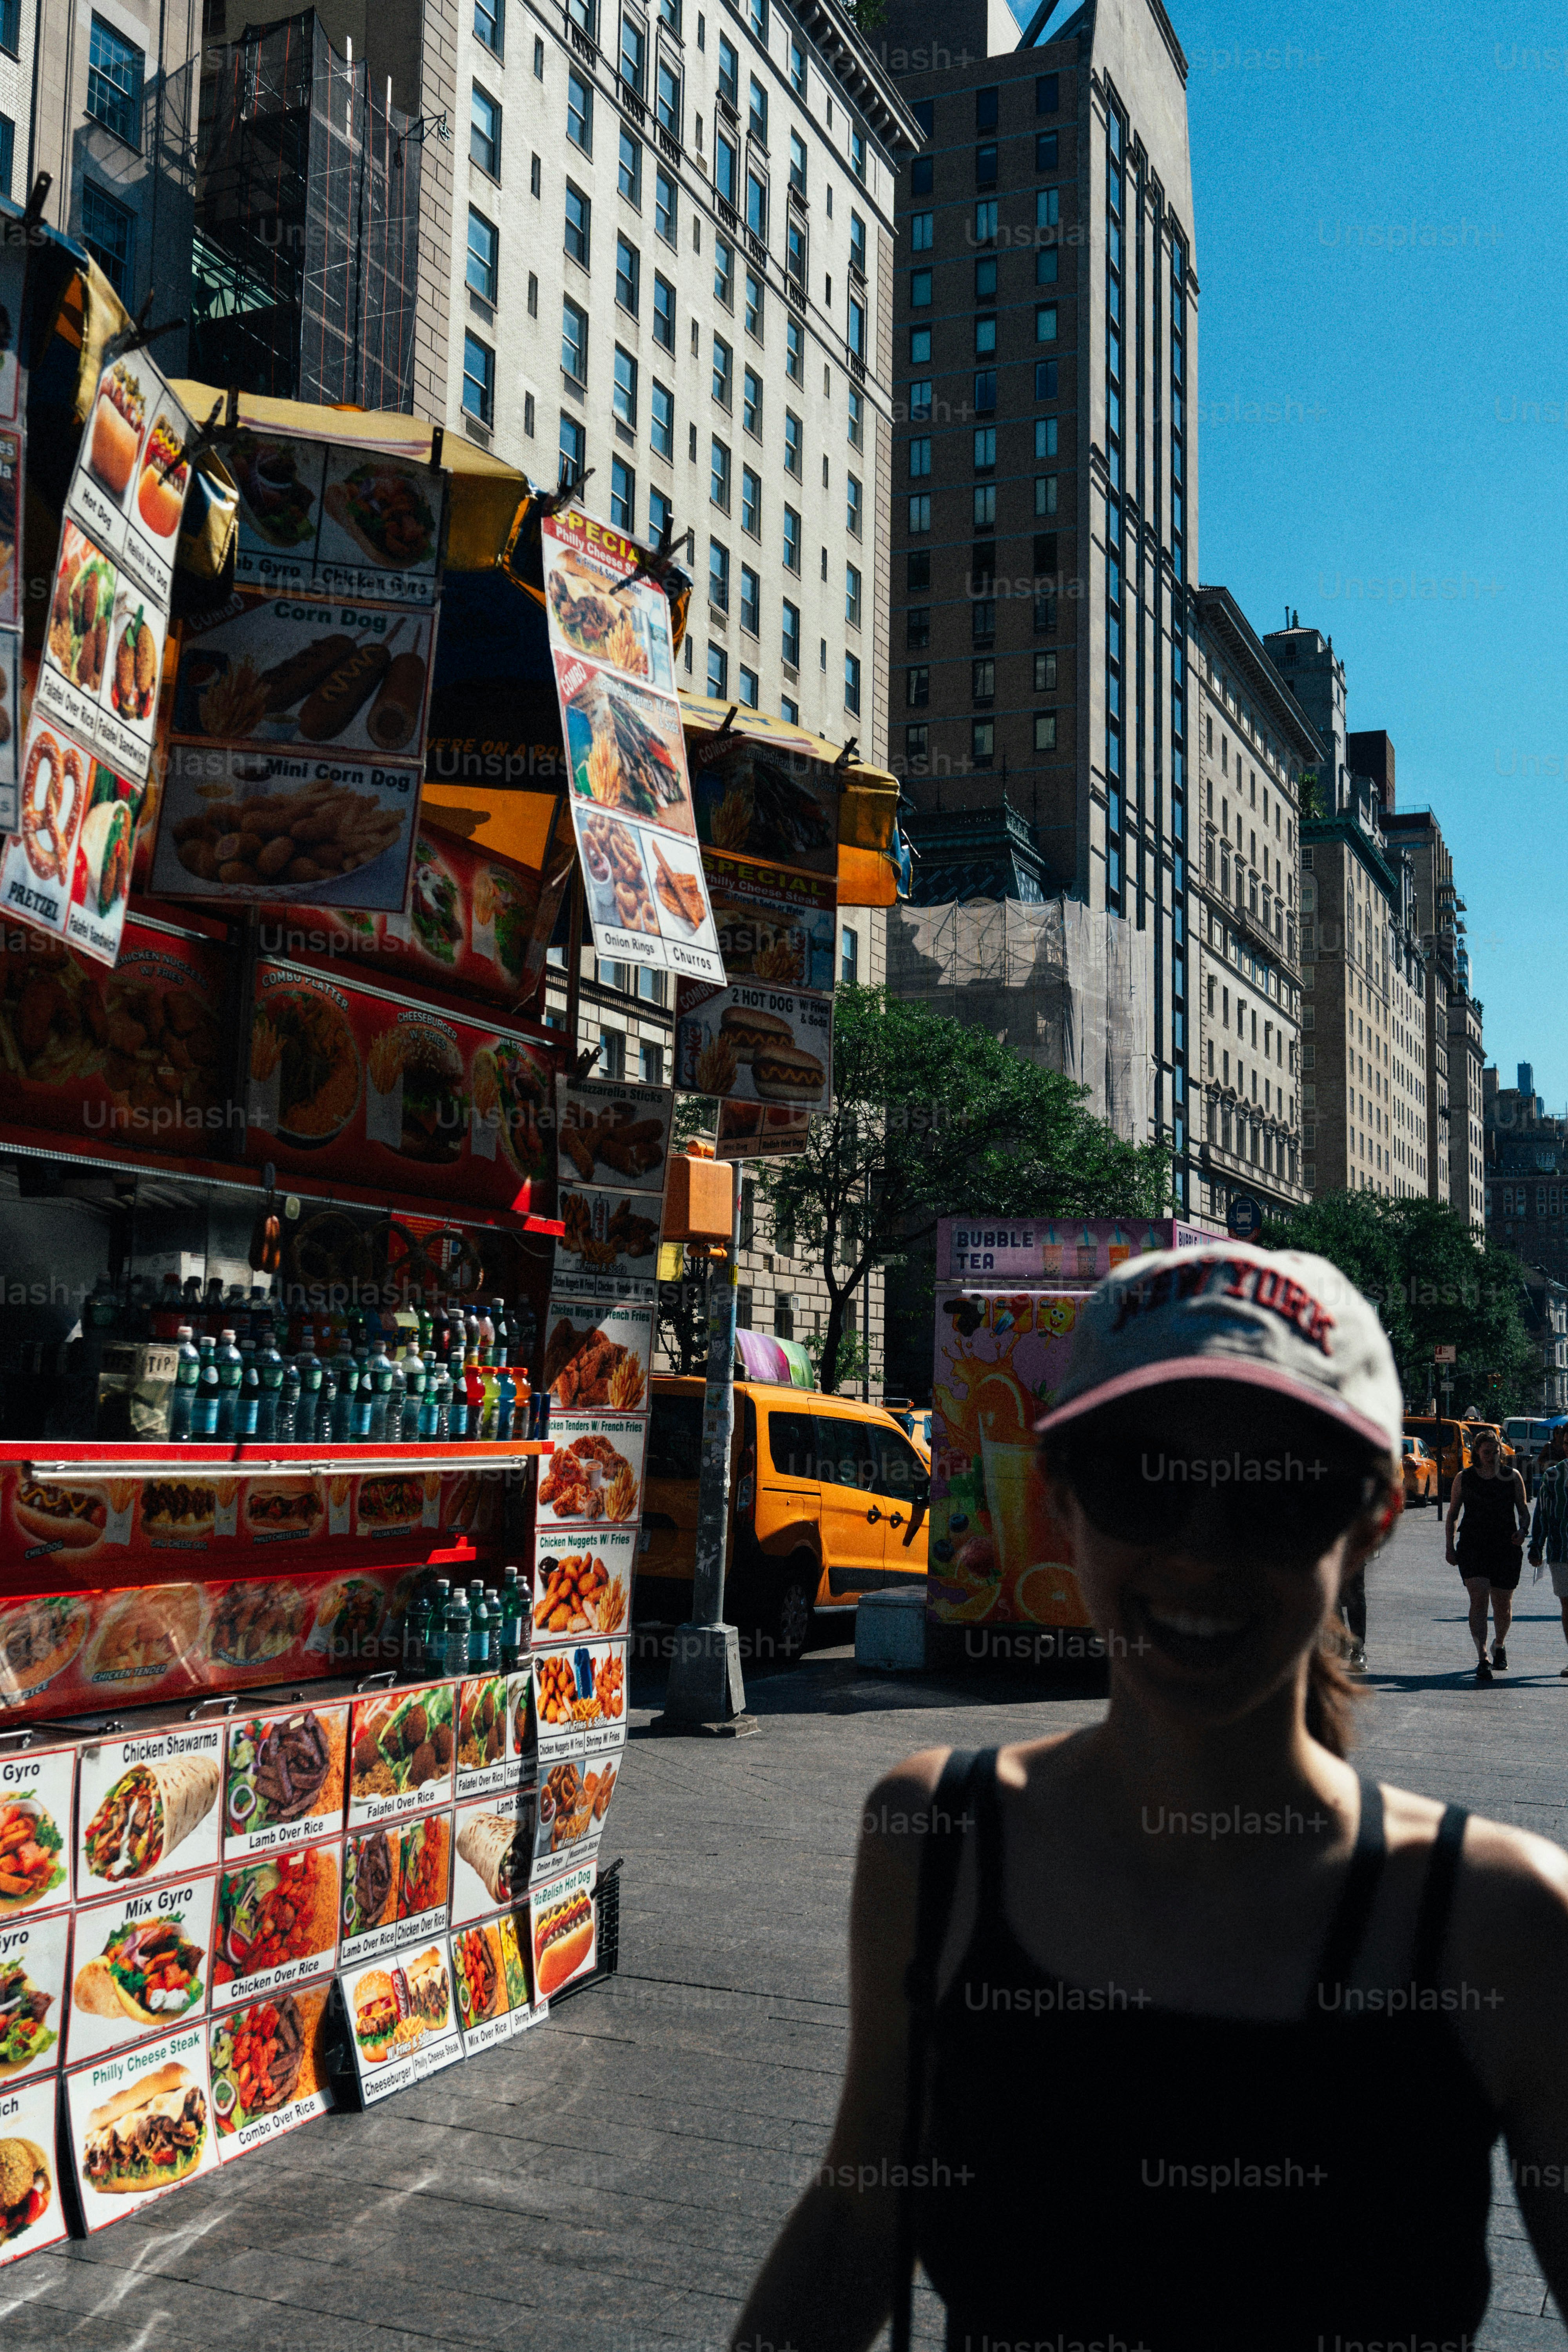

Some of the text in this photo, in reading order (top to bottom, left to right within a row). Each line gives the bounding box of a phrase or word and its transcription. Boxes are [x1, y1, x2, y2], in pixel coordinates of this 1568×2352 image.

[83, 488, 111, 530] Hot Dog
[556, 525, 623, 569] Philly Cheese
[260, 559, 300, 578] Gyro
[157, 570, 167, 593] Dog
[274, 601, 387, 634] Corn Dog
[560, 661, 587, 696] COMBO
[43, 675, 94, 729] Falafel Over Rice
[98, 717, 118, 745] Falafel
[664, 718, 679, 734] Soda
[265, 759, 410, 792] Mini Corn Dog
[701, 855, 826, 897] SPECIAL
[705, 873, 819, 906] Philly Cheese Steak
[733, 893, 751, 904] Fries
[8, 881, 58, 921] PRETZEL
[605, 932, 655, 955] Onion Rings
[115, 949, 160, 967] CHICKEN
[673, 947, 711, 970] Churros
[157, 967, 184, 985] FRIES
[261, 970, 349, 1013] COMBO PLATTER
[679, 982, 715, 1010] COMBO
[732, 987, 829, 1014] 2 HOT DOG Fries
[397, 1010, 458, 1041] CHEESEBURGER
[808, 1014, 827, 1028] Soda
[424, 1029, 447, 1050] FRIES
[629, 1089, 663, 1103] Sticks
[793, 1138, 804, 1148] Dog
[957, 1231, 1034, 1248] BUBBLE
[608, 1263, 627, 1274] Soda
[957, 1252, 994, 1269] TEA
[551, 1303, 650, 1321] Chicken Wings French Fries
[148, 1356, 172, 1371] TIP
[566, 1420, 642, 1433] Tenders French Fries
[253, 1534, 272, 1544] PHILLY
[272, 1531, 292, 1542] CHEESE
[372, 1526, 412, 1538] ITALIAN SAUSAGE
[540, 1536, 566, 1548] Chicken
[568, 1535, 597, 1548] Nuggets
[611, 1534, 630, 1544] Fries
[24, 1541, 63, 1559] CHILI DOG
[150, 1539, 208, 1550] CHILI CHEESE DOG
[92, 1664, 167, 1682] CHICKEN TENDER
[22, 1681, 49, 1699] RICE
[573, 1720, 587, 1731] Fries
[122, 1731, 218, 1764] Chicken Shawarma
[539, 1738, 583, 1755] Chicken Nuggets Fries
[586, 1731, 620, 1747] Shrimp Fries
[3, 1763, 40, 1784] Gyro
[459, 1772, 503, 1791] Falafel Over Rice
[367, 1791, 435, 1818] Falafel Over Rice
[497, 1797, 513, 1815] Lamb
[249, 1819, 324, 1849] Lamb Over Rice
[537, 1856, 563, 1872] Onion Rings
[564, 1875, 576, 1891] Hot
[578, 1870, 591, 1884] Dog
[125, 1888, 193, 1920] Mix Gyro
[397, 1912, 445, 1940] Chicken Over Rice
[343, 1932, 394, 1959] Lamb Over Rice
[231, 1959, 320, 1998] Chicken Over Rice
[514, 2012, 529, 2026] Shrimp
[468, 2022, 507, 2048] Mix Over Rice
[396, 2041, 412, 2055] Fries
[415, 2041, 459, 2071] Philly Cheese Steak
[92, 2031, 201, 2087] Philly Cheese Steak
[365, 2065, 412, 2097] Cheeseburger
[238, 2099, 316, 2146] Combo Over Rice
